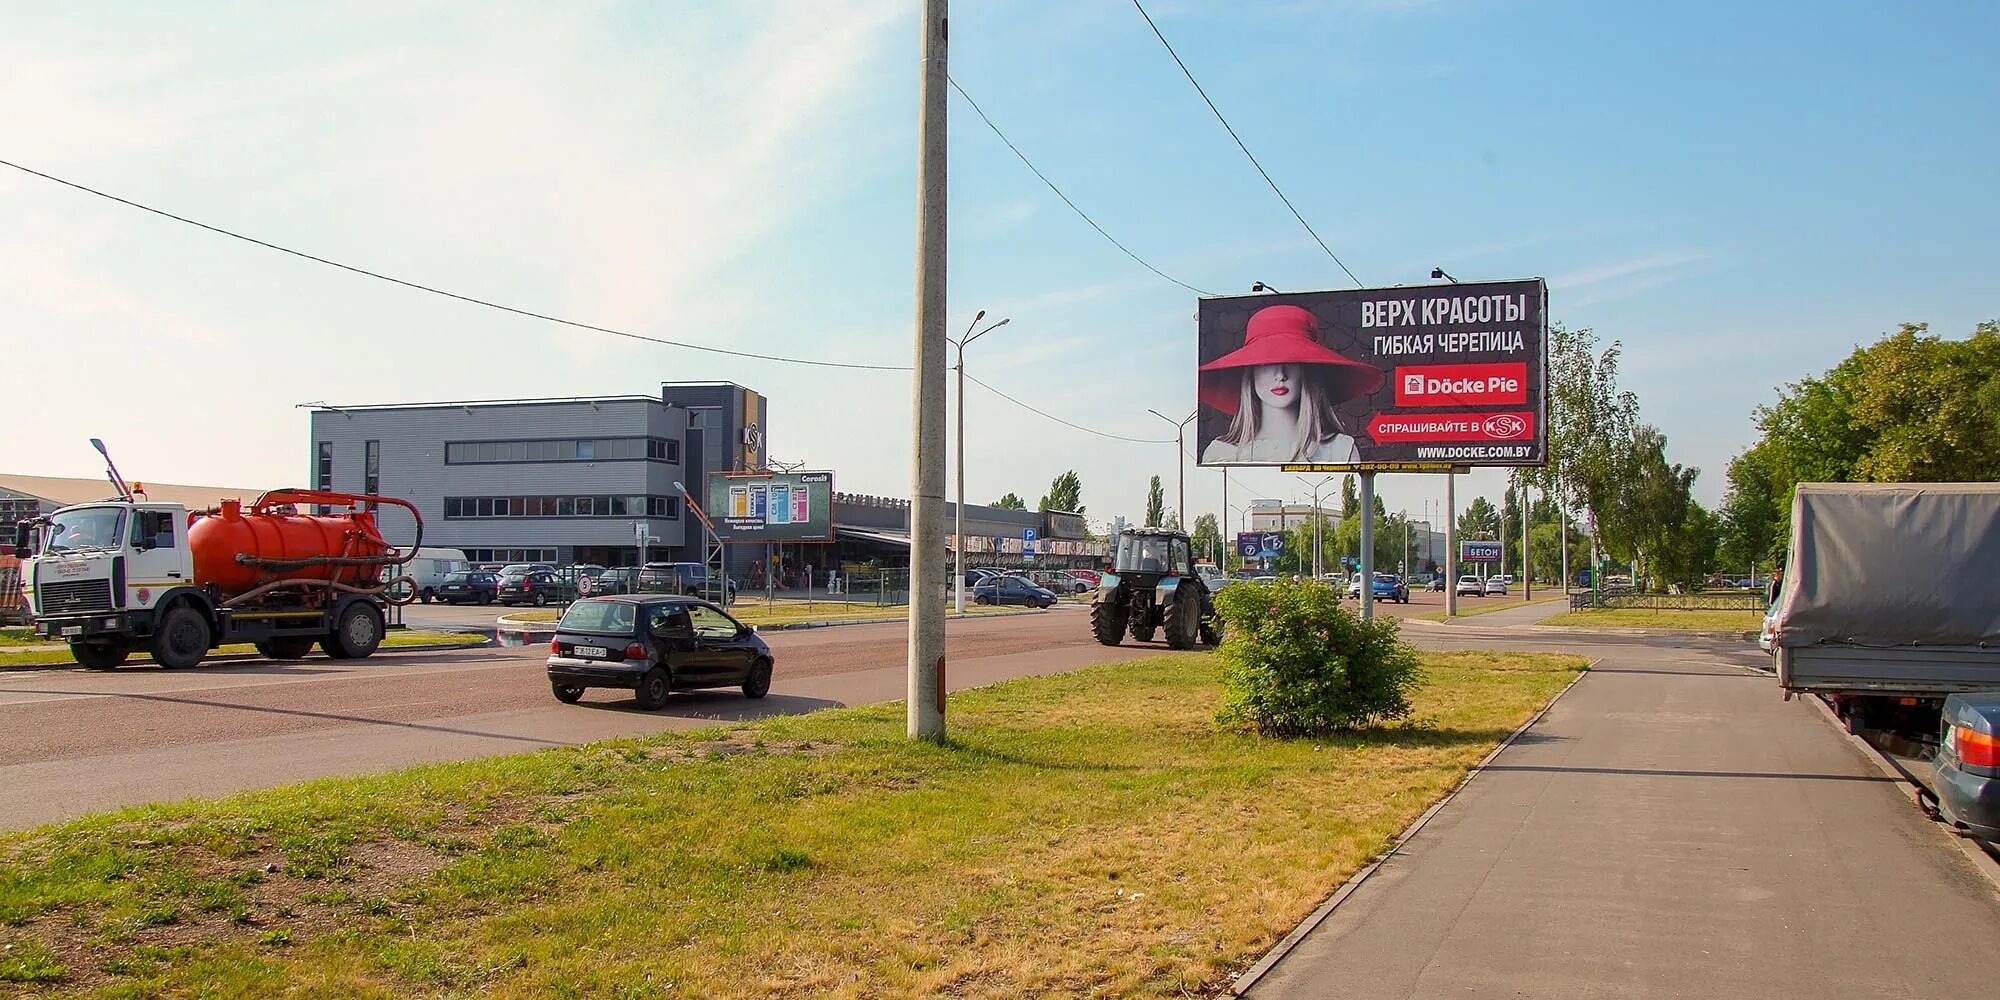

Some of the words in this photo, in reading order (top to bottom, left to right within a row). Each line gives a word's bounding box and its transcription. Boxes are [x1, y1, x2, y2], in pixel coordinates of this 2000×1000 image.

[1361, 299, 1416, 328] ВЕРХ
[1422, 294, 1526, 325] КРАСОТЫ
[1374, 334, 1434, 355] ГИБКАЯ
[1438, 330, 1525, 354] ЧЕРЕПИЦА
[1427, 378, 1485, 394] Döcke
[1488, 377, 1518, 393] Pie
[1378, 420, 1468, 434] СПРАШИВАЙТЕ
[1471, 422, 1480, 432] В
[1485, 417, 1522, 436] KSK
[744, 422, 763, 453] KSK
[1417, 446, 1532, 459] WWW.DOCKE.COM.BY
[1026, 530, 1033, 540] P
[1470, 548, 1498, 556] БЕТОН
[582, 581, 588, 589] 5
